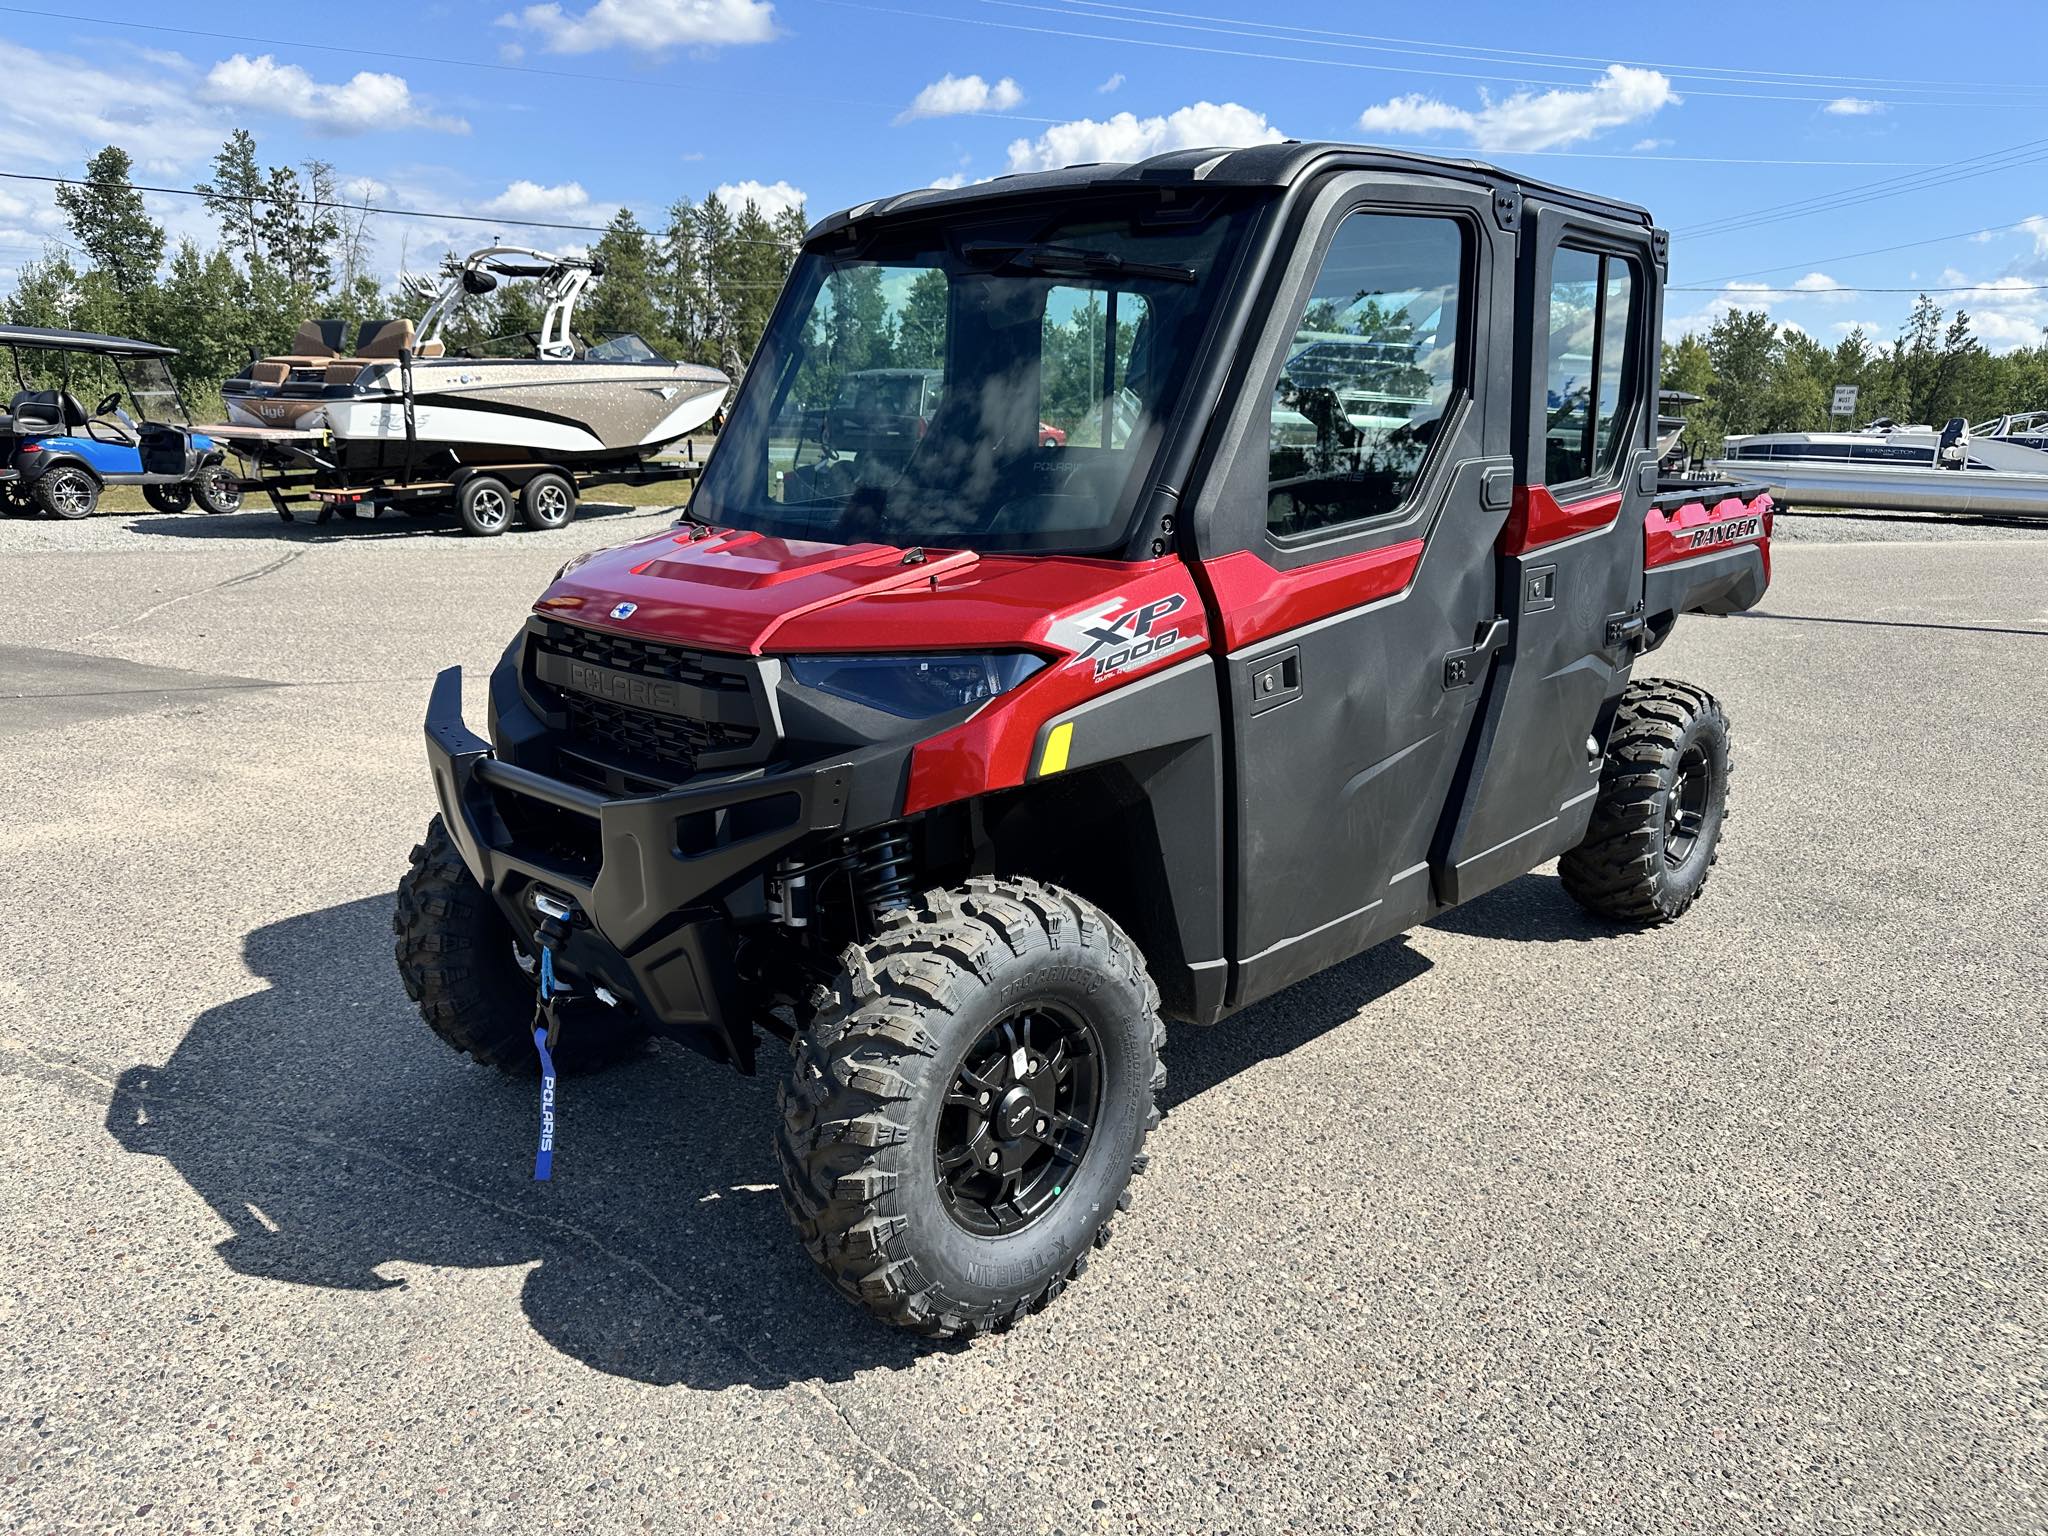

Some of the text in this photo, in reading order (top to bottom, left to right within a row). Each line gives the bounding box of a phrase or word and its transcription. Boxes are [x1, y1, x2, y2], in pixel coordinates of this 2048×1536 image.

[1689, 518, 1758, 550] RANGER
[1066, 593, 1187, 666] XP
[1094, 628, 1179, 679] 1000
[571, 663, 676, 706] POLARIS
[541, 1076, 555, 1152] POLARIS
[964, 1234, 1071, 1288] X-TERRAIN
